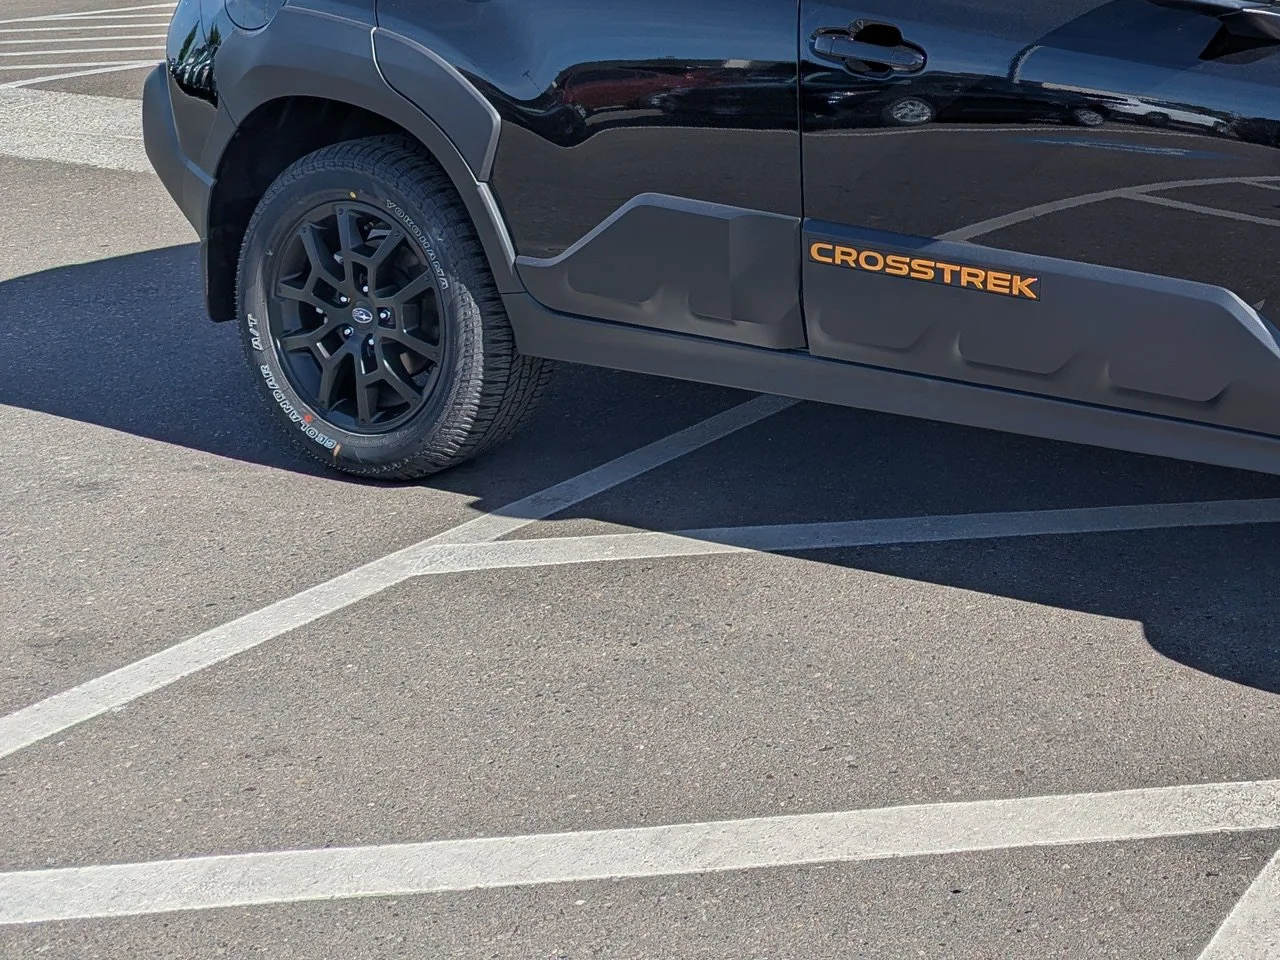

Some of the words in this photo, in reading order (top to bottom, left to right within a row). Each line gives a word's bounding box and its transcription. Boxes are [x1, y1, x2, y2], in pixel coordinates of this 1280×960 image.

[387, 199, 449, 290] YOKOHAMA
[810, 242, 1038, 299] CROSSTREK
[247, 313, 263, 351] A/T
[260, 364, 337, 449] GEOLANDAR
